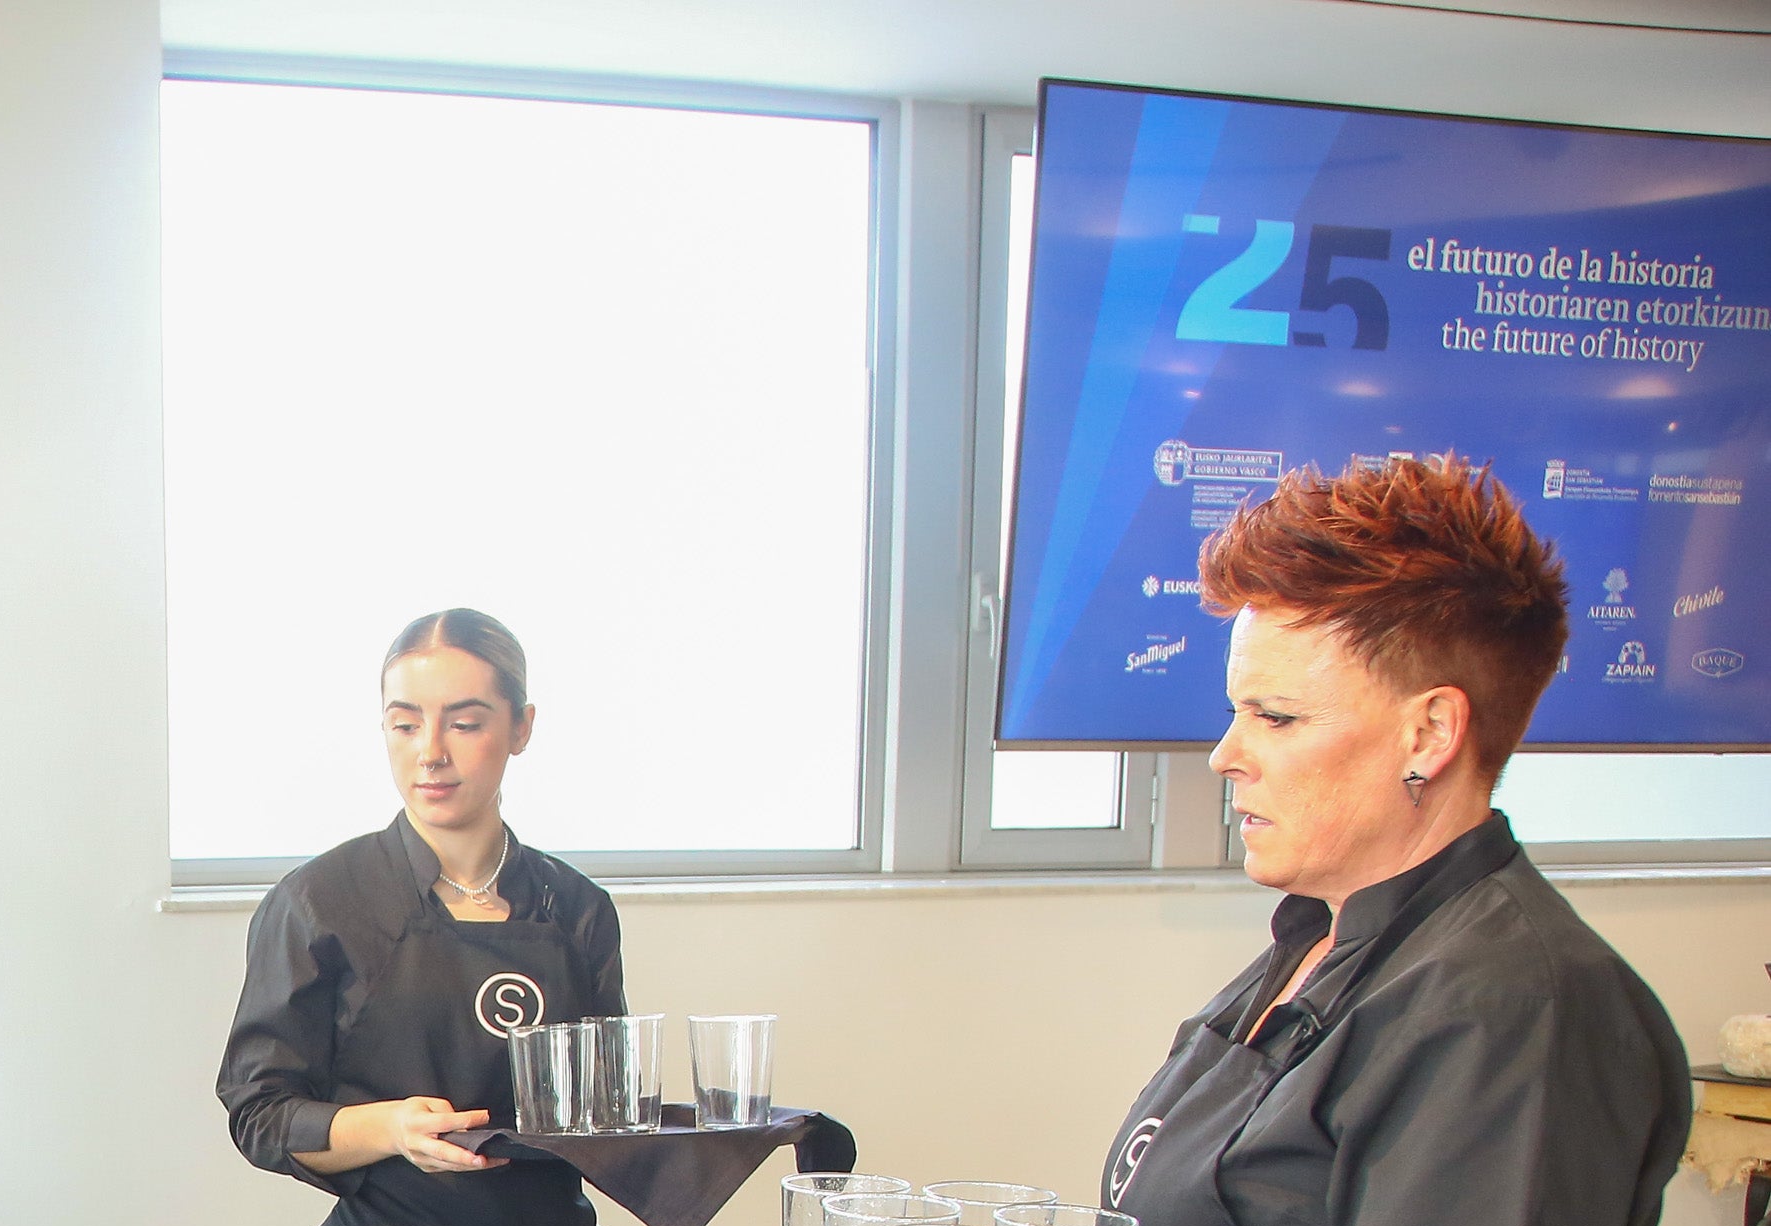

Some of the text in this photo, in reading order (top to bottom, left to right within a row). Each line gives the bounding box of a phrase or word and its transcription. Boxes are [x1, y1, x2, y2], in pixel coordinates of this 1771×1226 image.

[1407, 238, 1714, 289] el futuro de la historia
[1475, 280, 1771, 330] historiaren etorkizun
[1442, 317, 1704, 372] the future of history
[1239, 467, 1266, 477] VASCO
[1606, 664, 1655, 677] ZAPIAIN
[494, 982, 526, 1028] S
